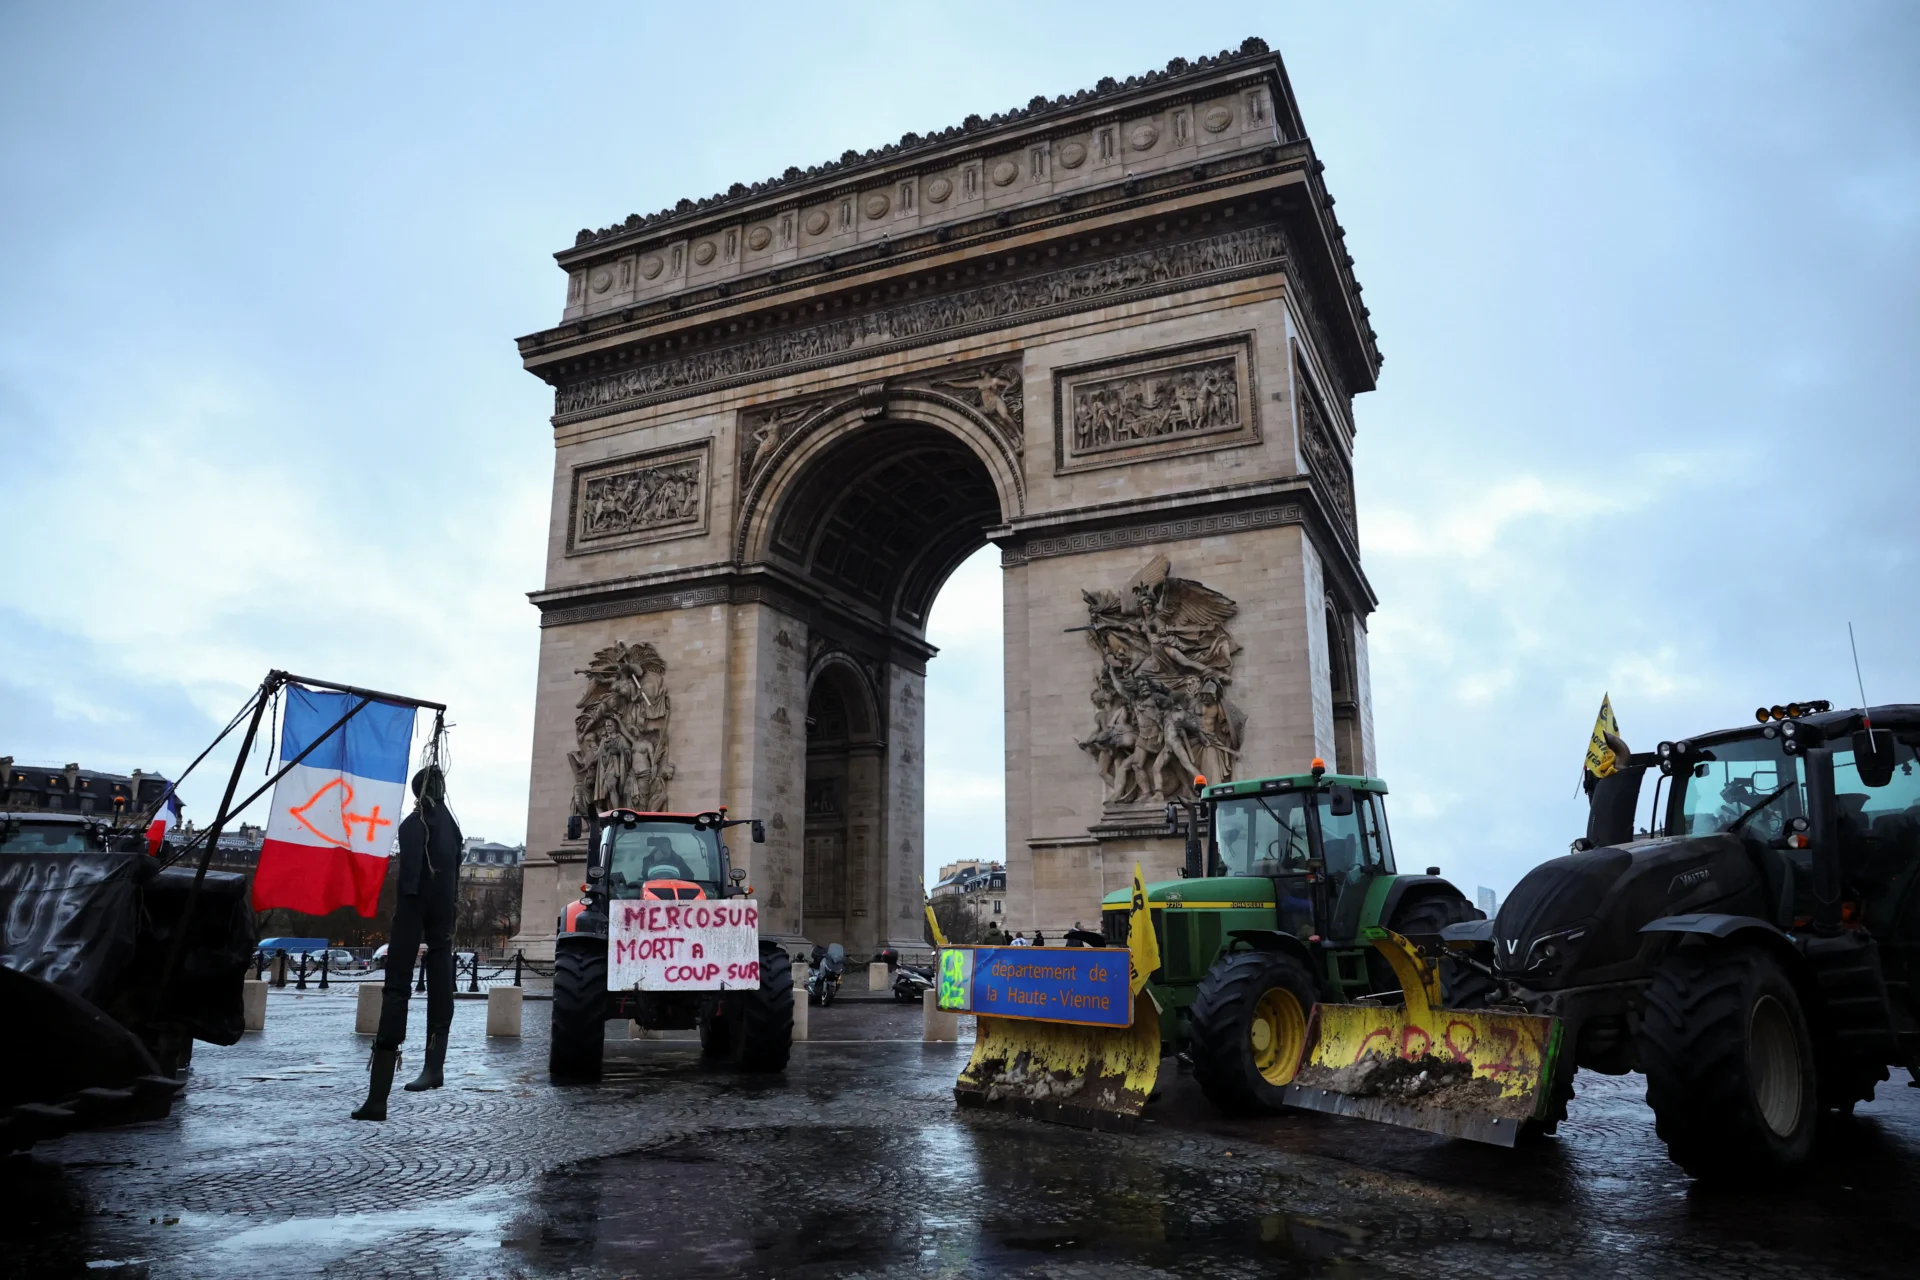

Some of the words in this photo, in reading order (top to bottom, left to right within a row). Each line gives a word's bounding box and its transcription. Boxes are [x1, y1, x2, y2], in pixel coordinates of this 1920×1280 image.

[623, 906, 758, 931] MERCOSUR
[616, 938, 684, 964] MORT
[691, 943, 704, 959] A
[664, 963, 720, 983] COUP
[727, 961, 760, 981] SUR
[991, 959, 1077, 983] département
[1089, 963, 1107, 982] de
[987, 984, 997, 1001] la
